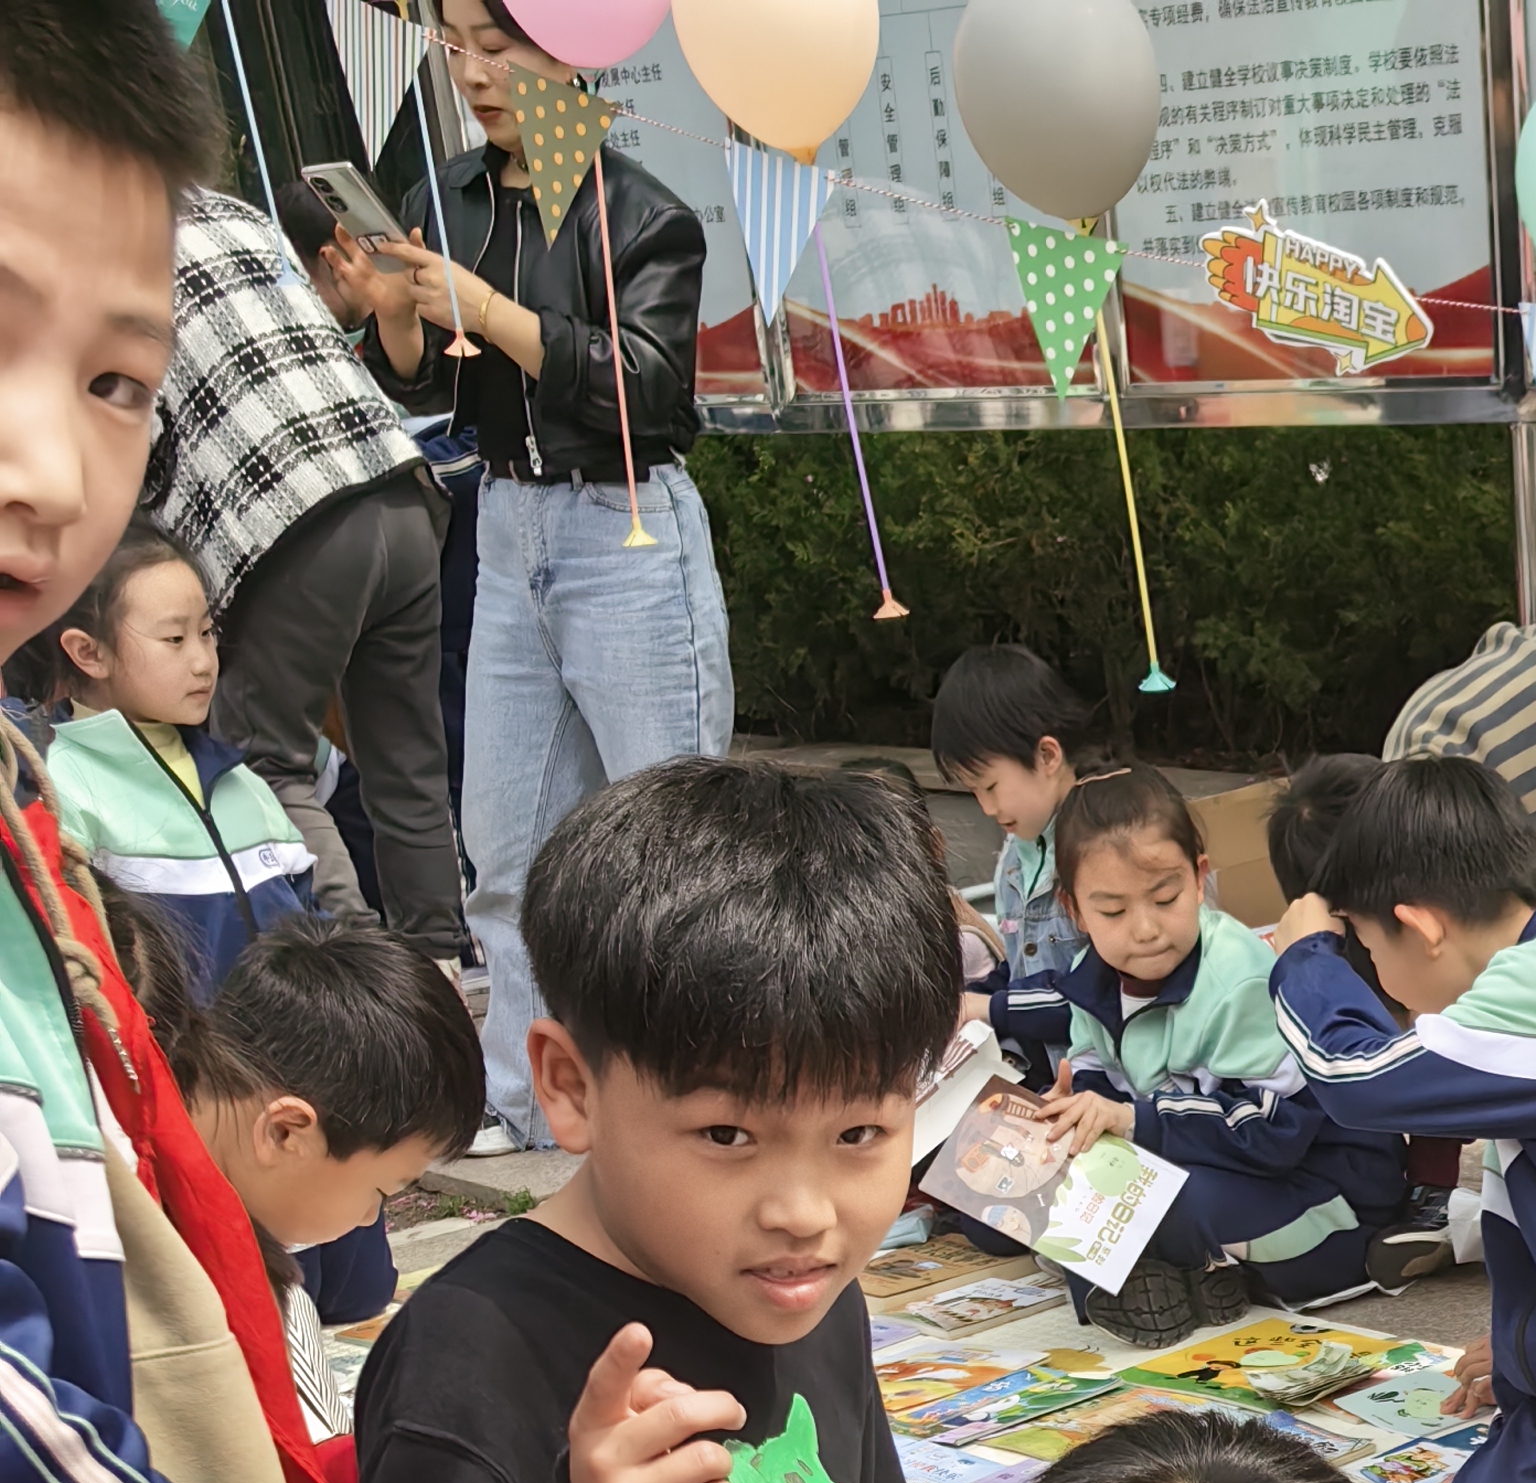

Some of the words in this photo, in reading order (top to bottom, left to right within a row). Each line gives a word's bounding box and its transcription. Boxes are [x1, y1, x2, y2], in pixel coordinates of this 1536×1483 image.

[1285, 236, 1359, 284] HAPPY
[1243, 255, 1399, 345] 快乐淘宝
